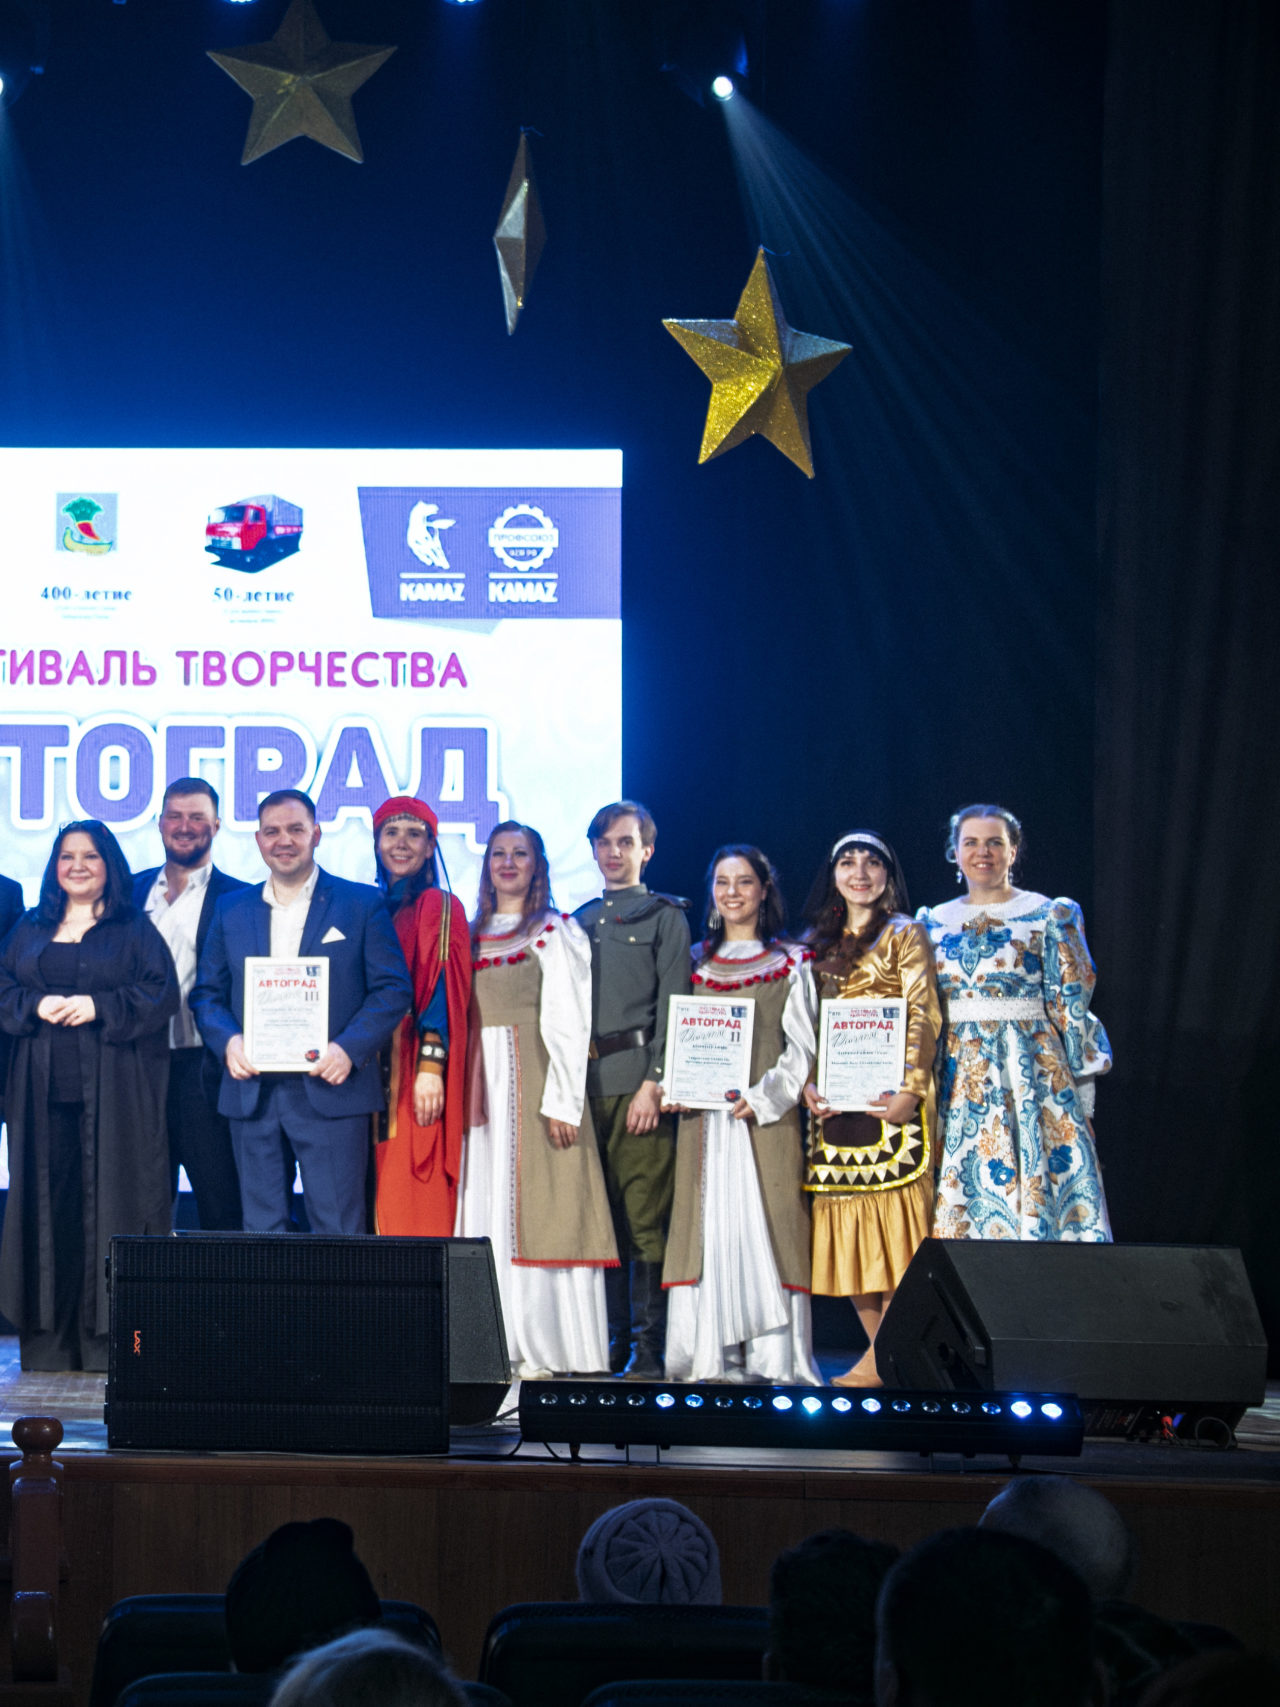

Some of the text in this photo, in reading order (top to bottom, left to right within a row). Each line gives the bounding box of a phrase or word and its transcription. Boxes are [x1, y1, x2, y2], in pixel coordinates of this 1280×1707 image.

[399, 582, 466, 602] KAMAZ
[488, 581, 558, 603] KAMAZ
[175, 651, 468, 688] ТВОРЧЕСТВА
[258, 979, 317, 988] АВТОГРАД
[681, 1017, 742, 1030] АВТОГРАД
[833, 1020, 894, 1031] АВТОГРАД
